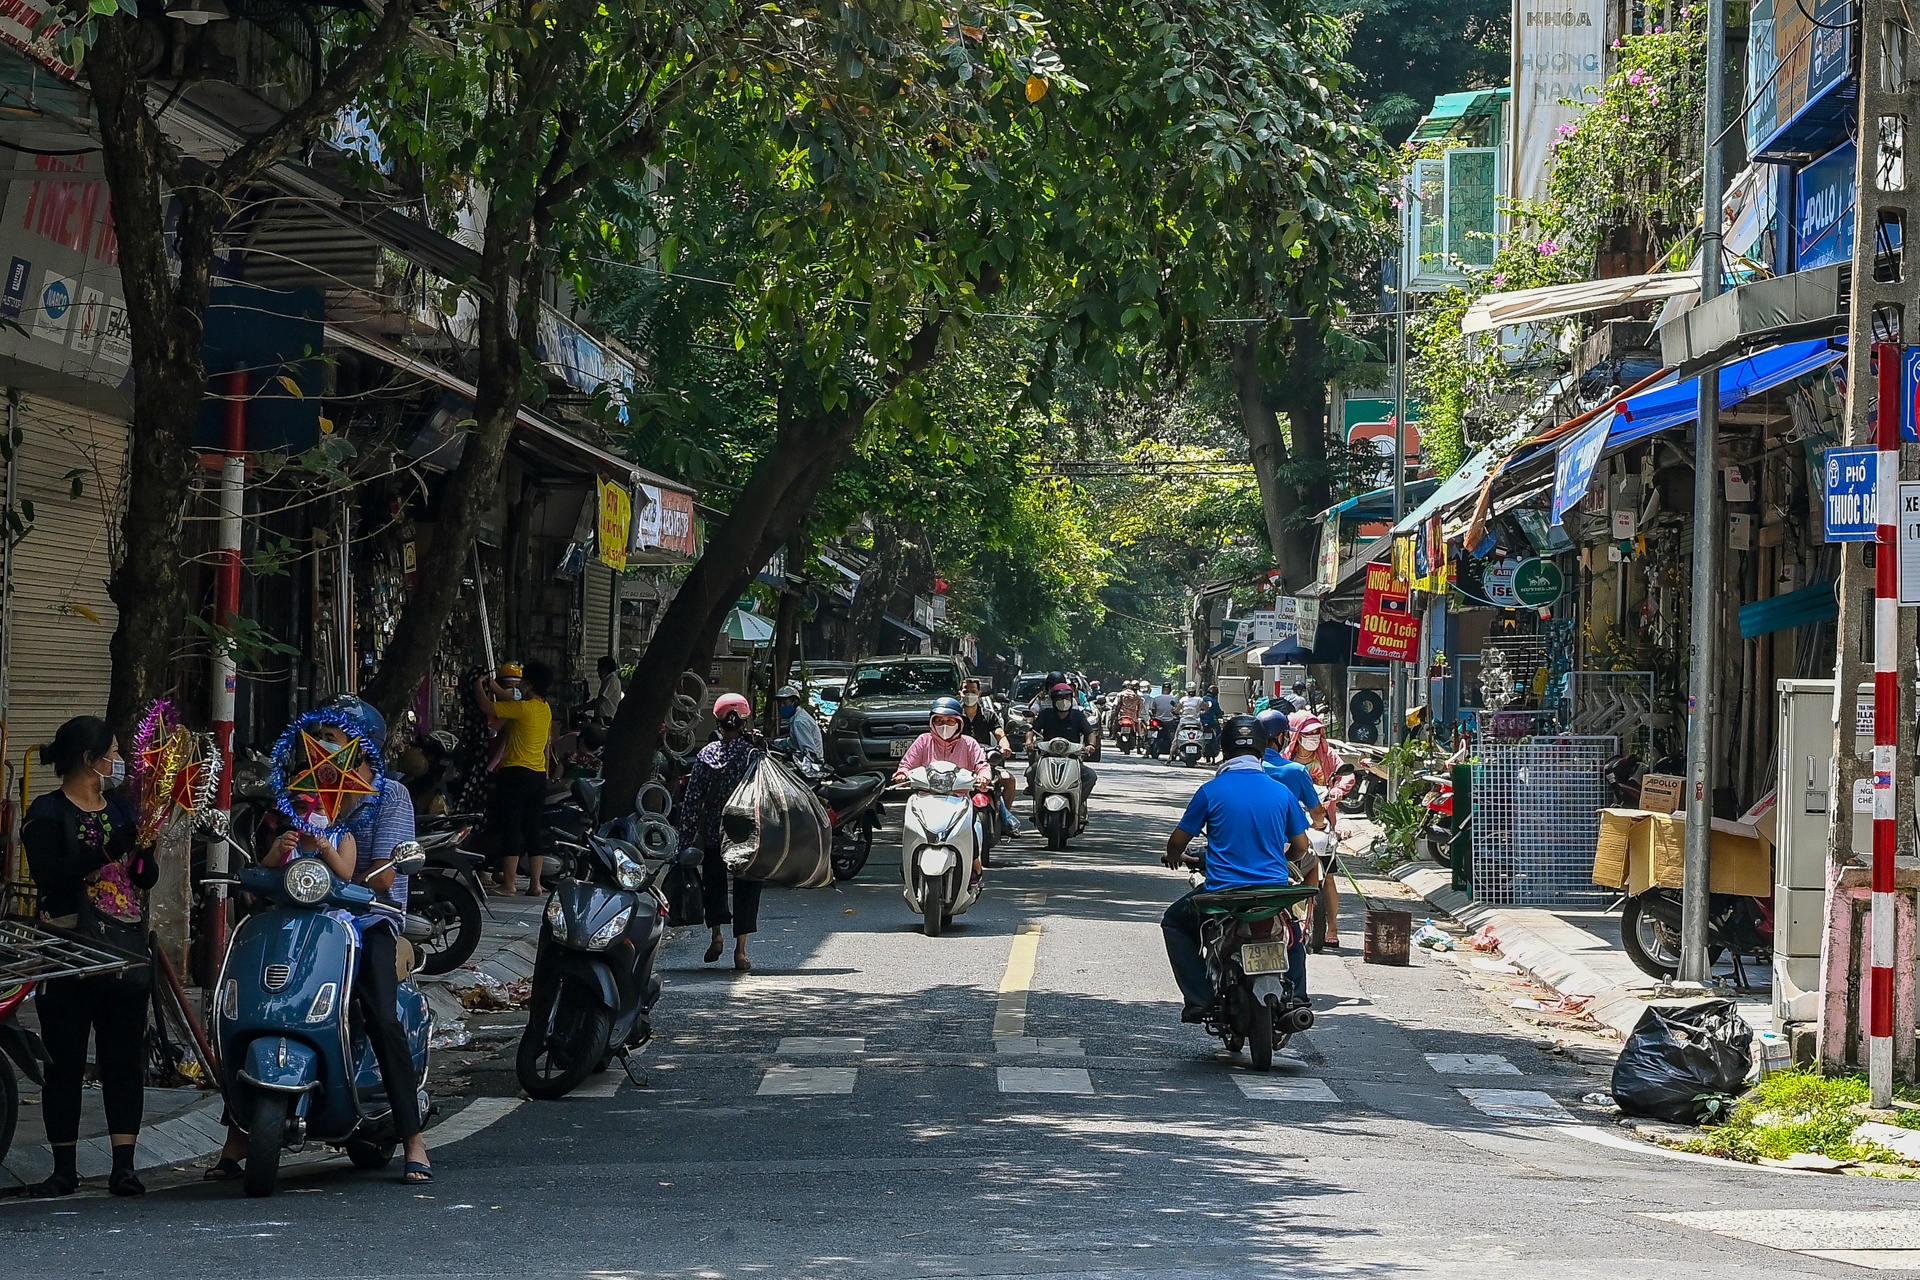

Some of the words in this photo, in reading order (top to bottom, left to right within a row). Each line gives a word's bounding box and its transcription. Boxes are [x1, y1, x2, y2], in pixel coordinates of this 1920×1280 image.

[1526, 8, 1592, 27] KHÓA
[1520, 52, 1599, 71] HƯƠNG
[1535, 82, 1584, 100] NAM
[1802, 184, 1836, 239] APOLLO
[1846, 458, 1866, 483] PHỐ
[1829, 484, 1860, 525] THUỐC
[1905, 497, 1919, 512] XE
[1372, 634, 1408, 648] 700ml
[1645, 778, 1678, 788] APOLLO
